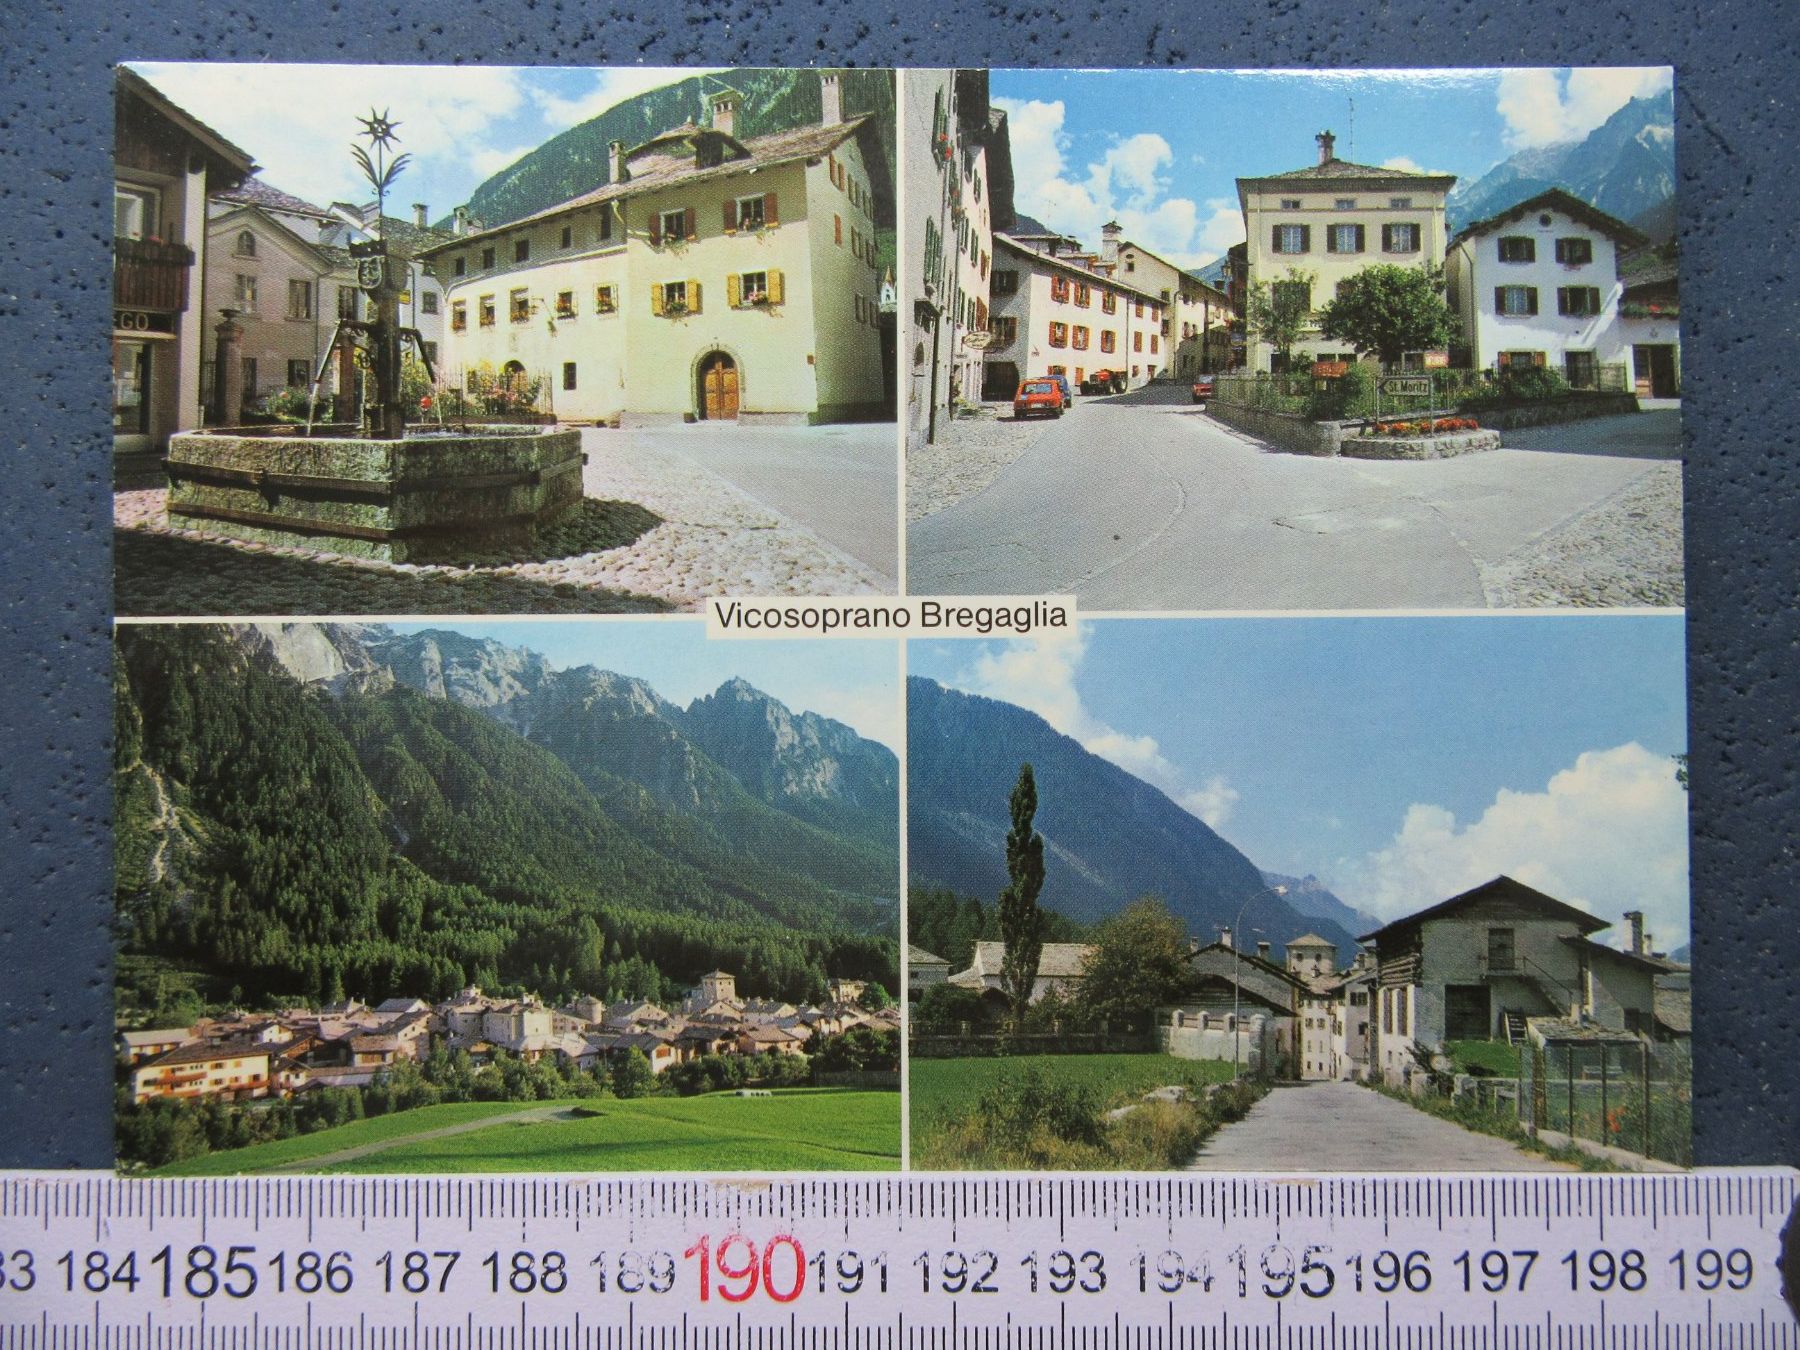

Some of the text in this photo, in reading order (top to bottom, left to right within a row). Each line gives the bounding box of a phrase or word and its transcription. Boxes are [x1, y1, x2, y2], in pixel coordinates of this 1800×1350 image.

[1400, 380, 1428, 392] Moritz
[714, 600, 1067, 634] Vicosoprano Bregaglia
[0, 1234, 1754, 1303] 3 184 185 186 187 188 189 190 191 192 193 194 195 196 197 198 199
